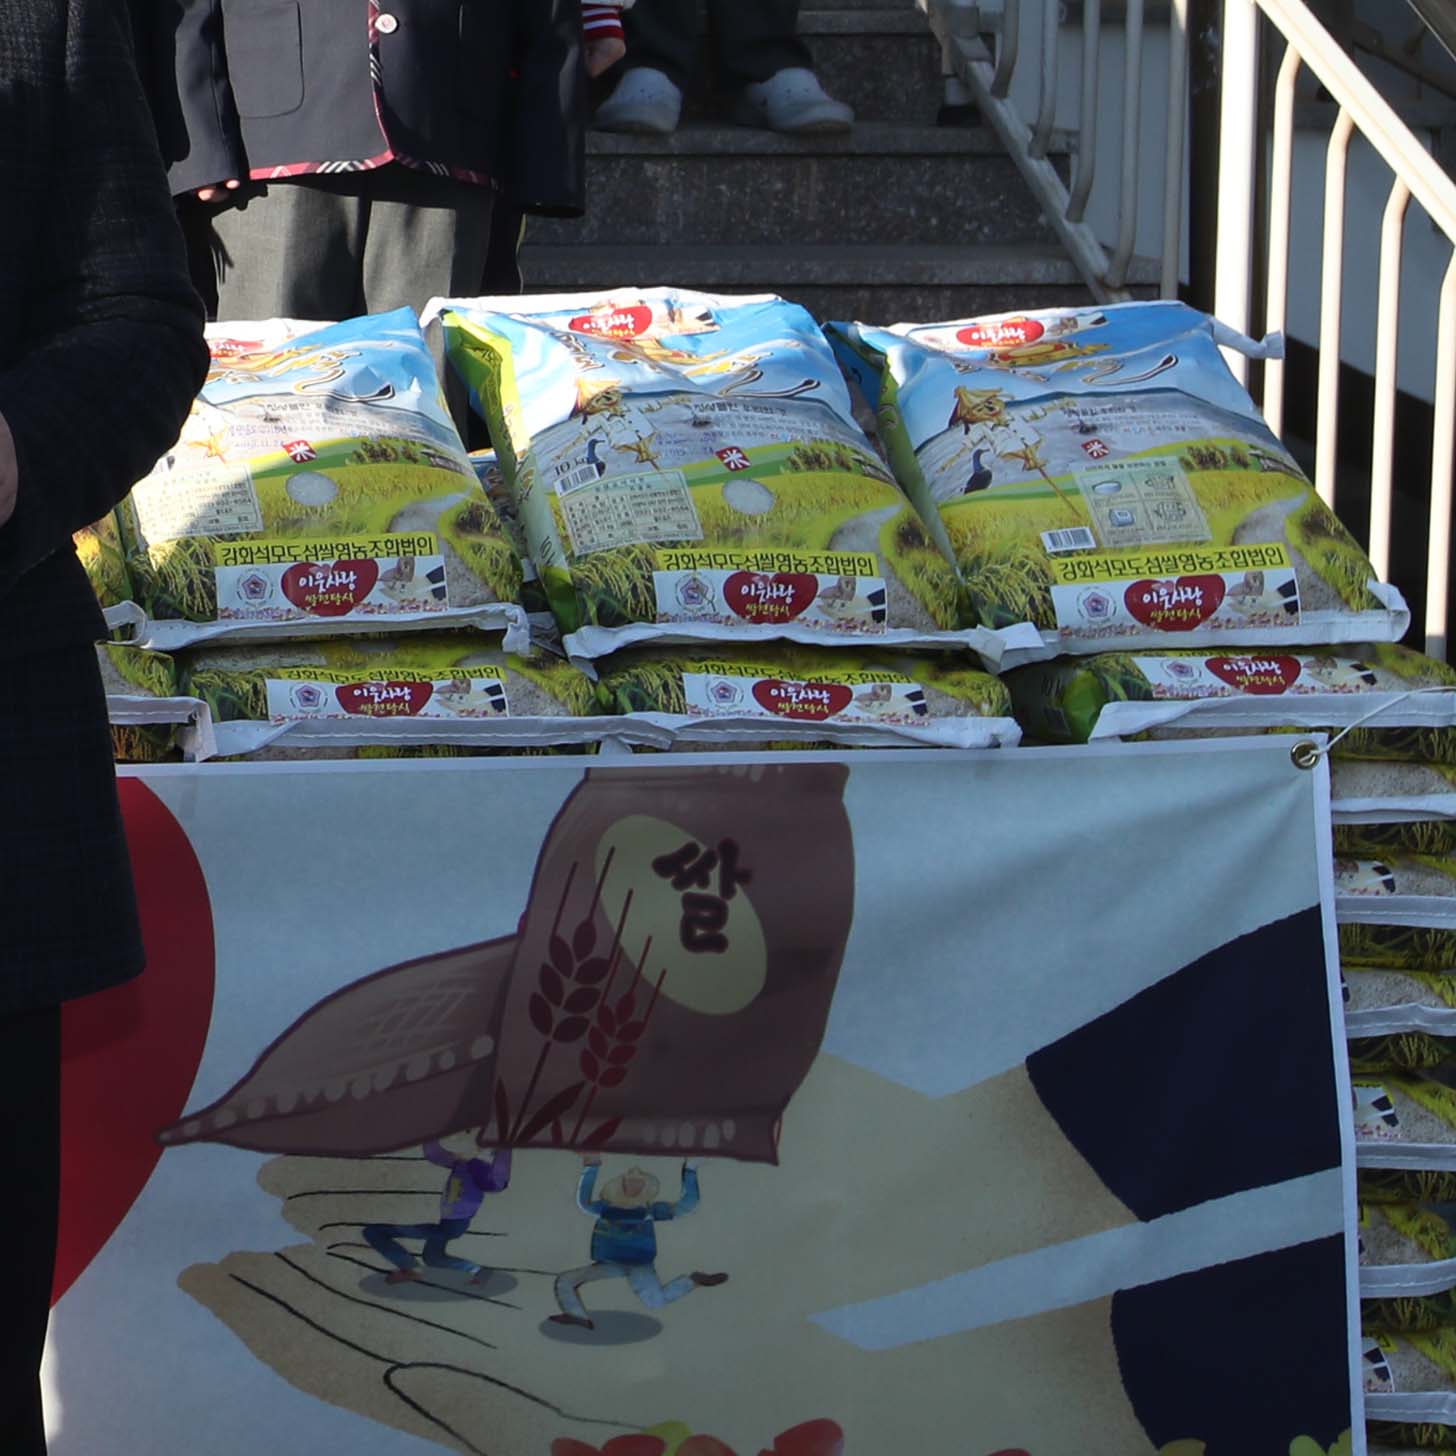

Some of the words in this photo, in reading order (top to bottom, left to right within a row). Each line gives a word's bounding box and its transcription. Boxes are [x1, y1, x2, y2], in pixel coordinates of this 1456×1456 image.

[299, 570, 357, 593] 이웃사랑
[740, 582, 795, 604] 이웃사랑
[1142, 586, 1203, 609] 이웃사랑
[353, 686, 412, 703] 이웃사랑
[770, 685, 831, 704] 이웃사랑
